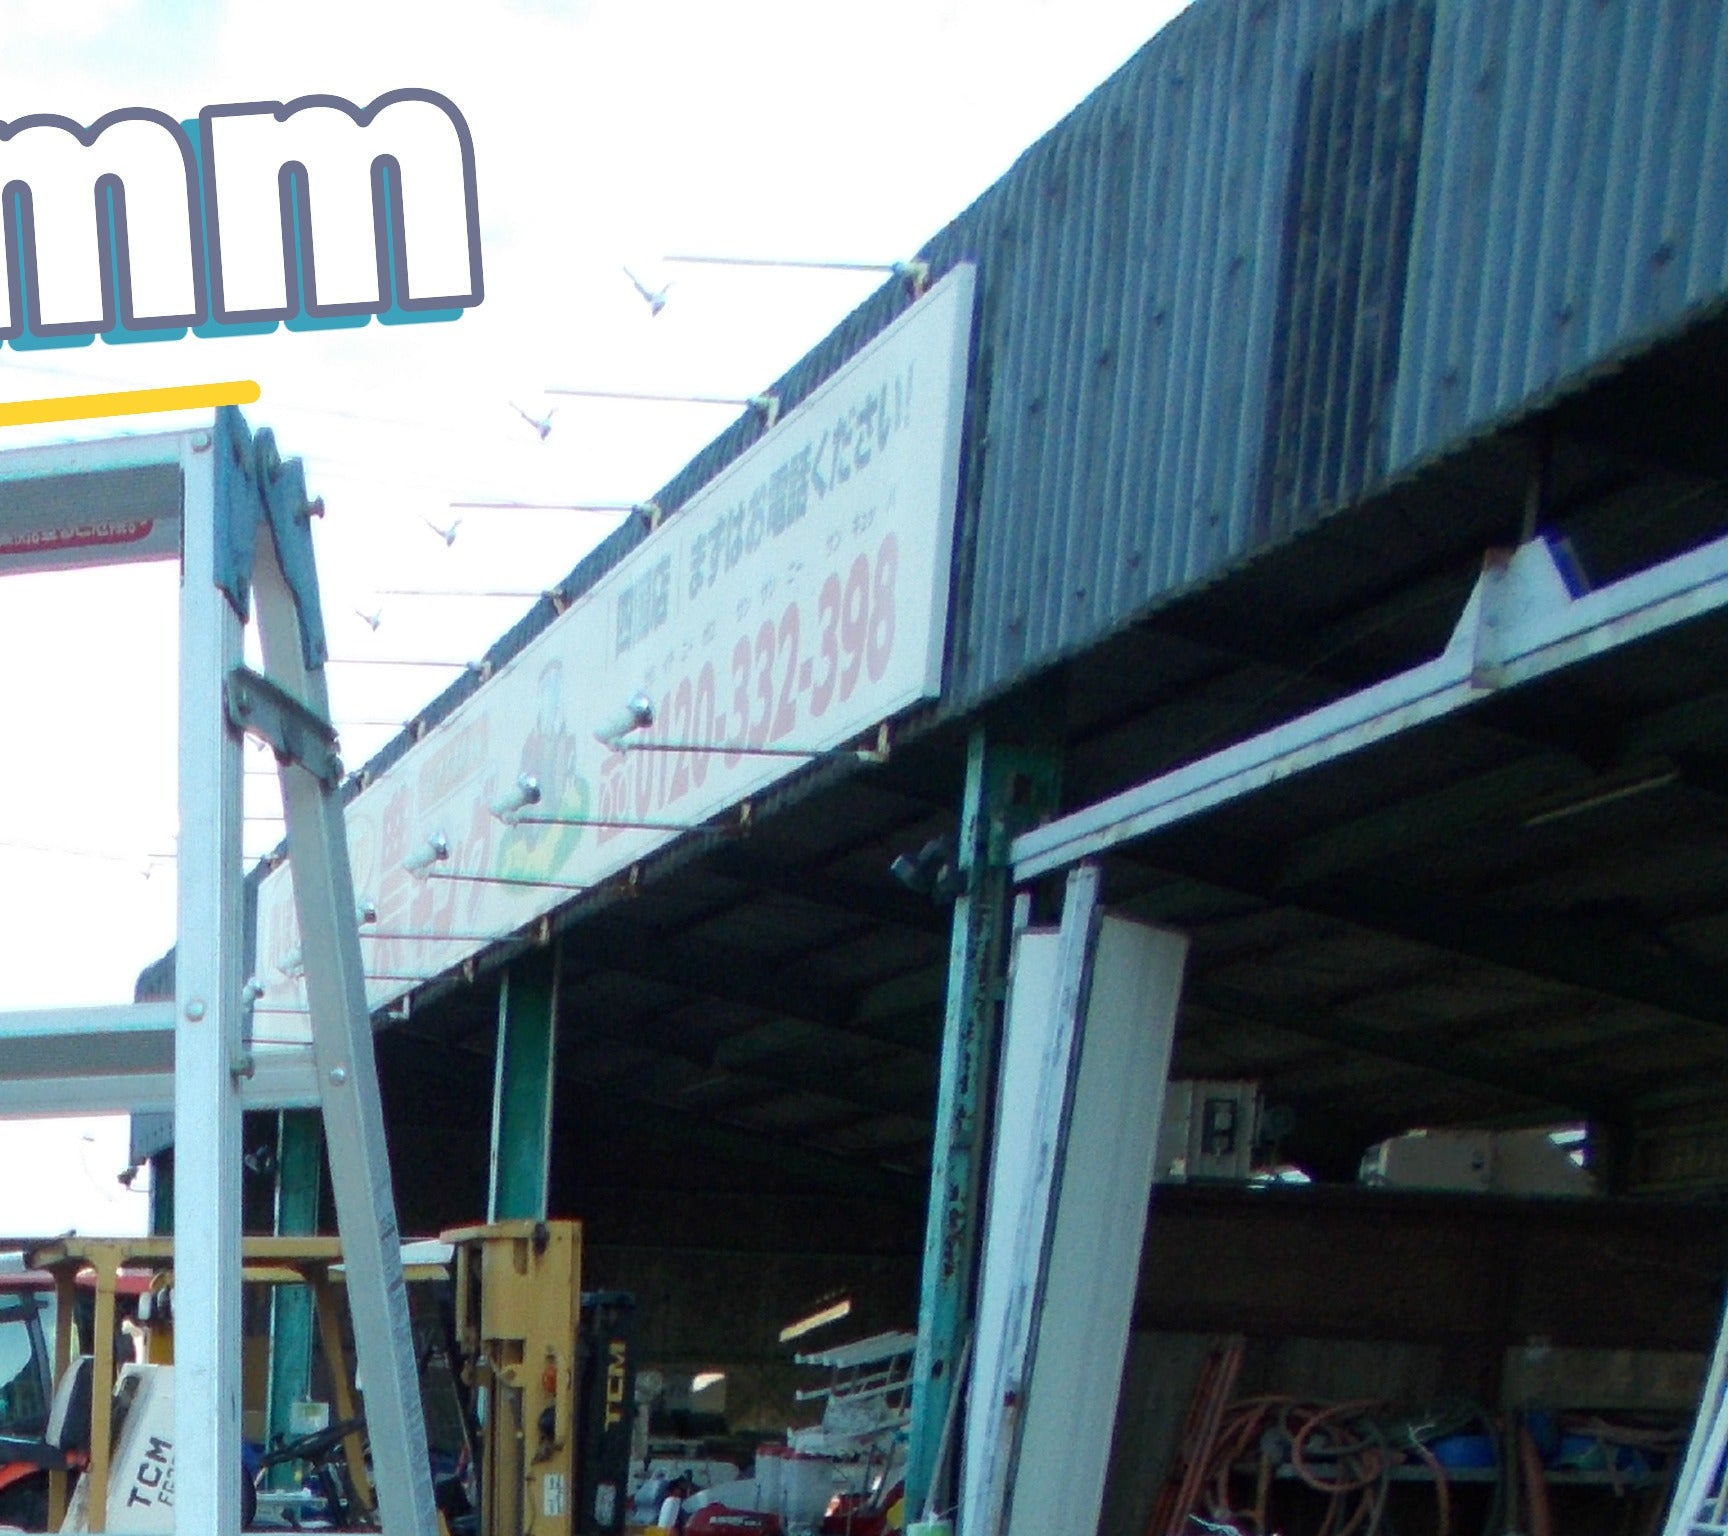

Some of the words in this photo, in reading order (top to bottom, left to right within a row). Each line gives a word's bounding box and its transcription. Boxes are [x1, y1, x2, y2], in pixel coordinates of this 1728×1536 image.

[634, 527, 900, 824] 0120-332-398
[603, 1340, 626, 1431] TCM
[126, 1436, 173, 1508] TCM
